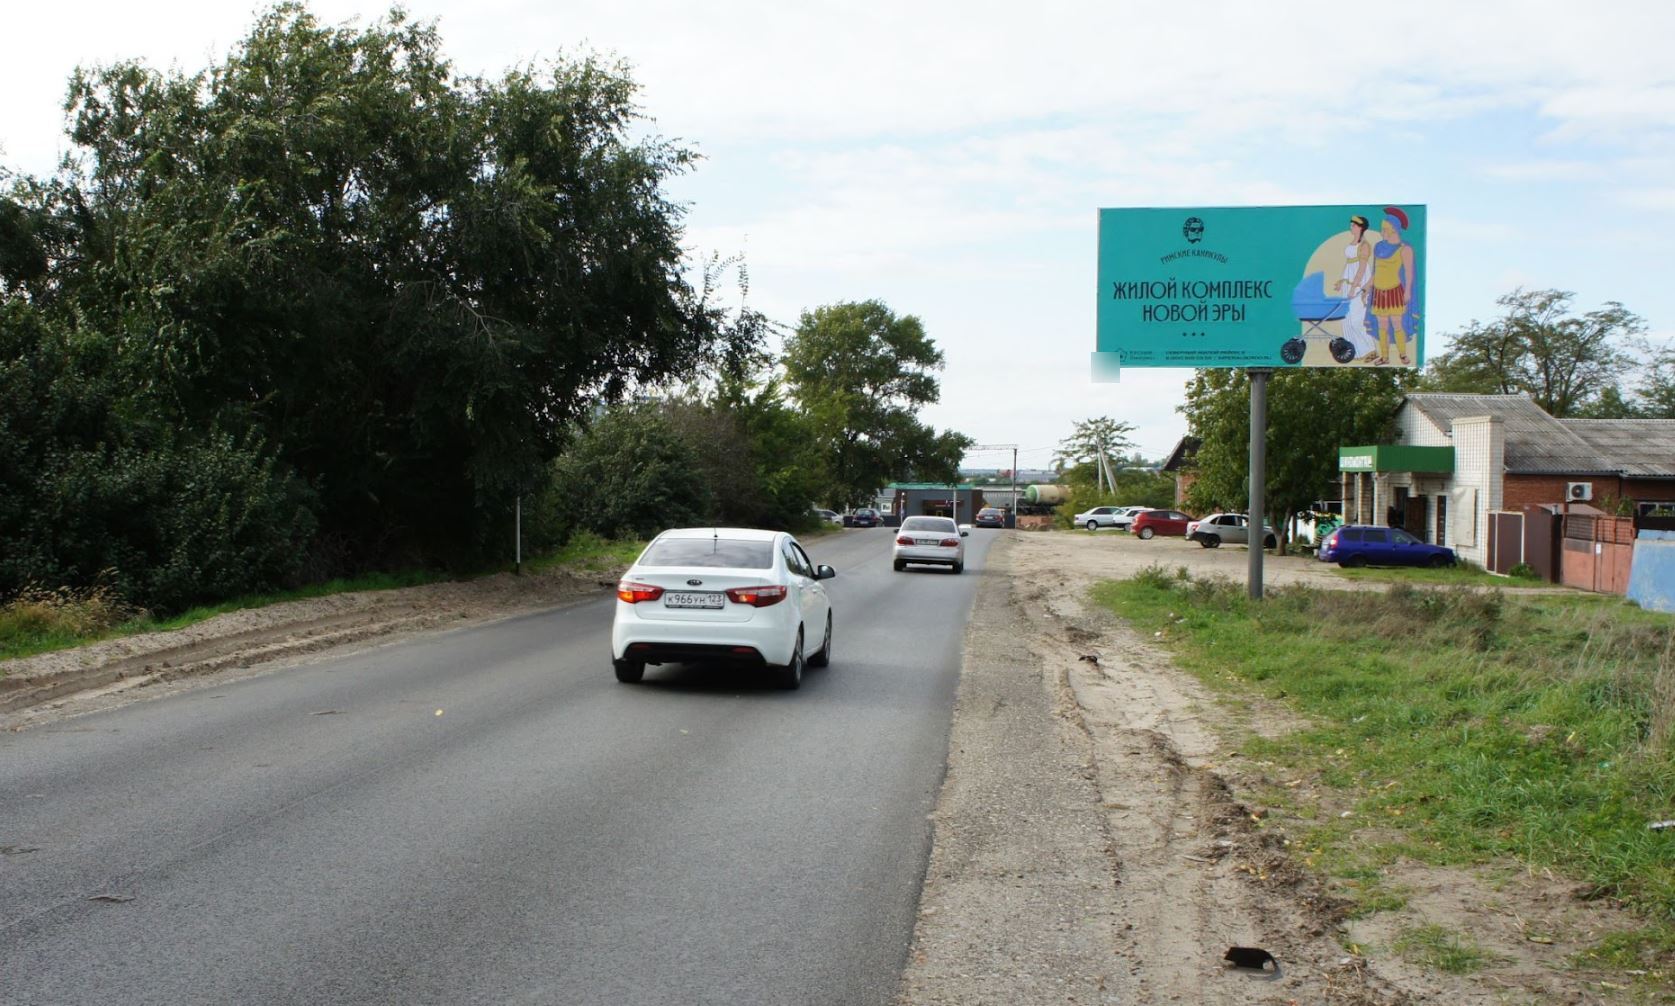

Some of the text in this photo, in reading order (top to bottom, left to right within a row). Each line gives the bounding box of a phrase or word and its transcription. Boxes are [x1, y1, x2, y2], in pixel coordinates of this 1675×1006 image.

[1161, 249, 1228, 265] РИМСКИЕ КАНИКУЛЫ
[1113, 277, 1272, 299] ЖИЛОЙ КОМПЛЕКС
[1143, 300, 1246, 322] НОВОЙ ЭРЫ
